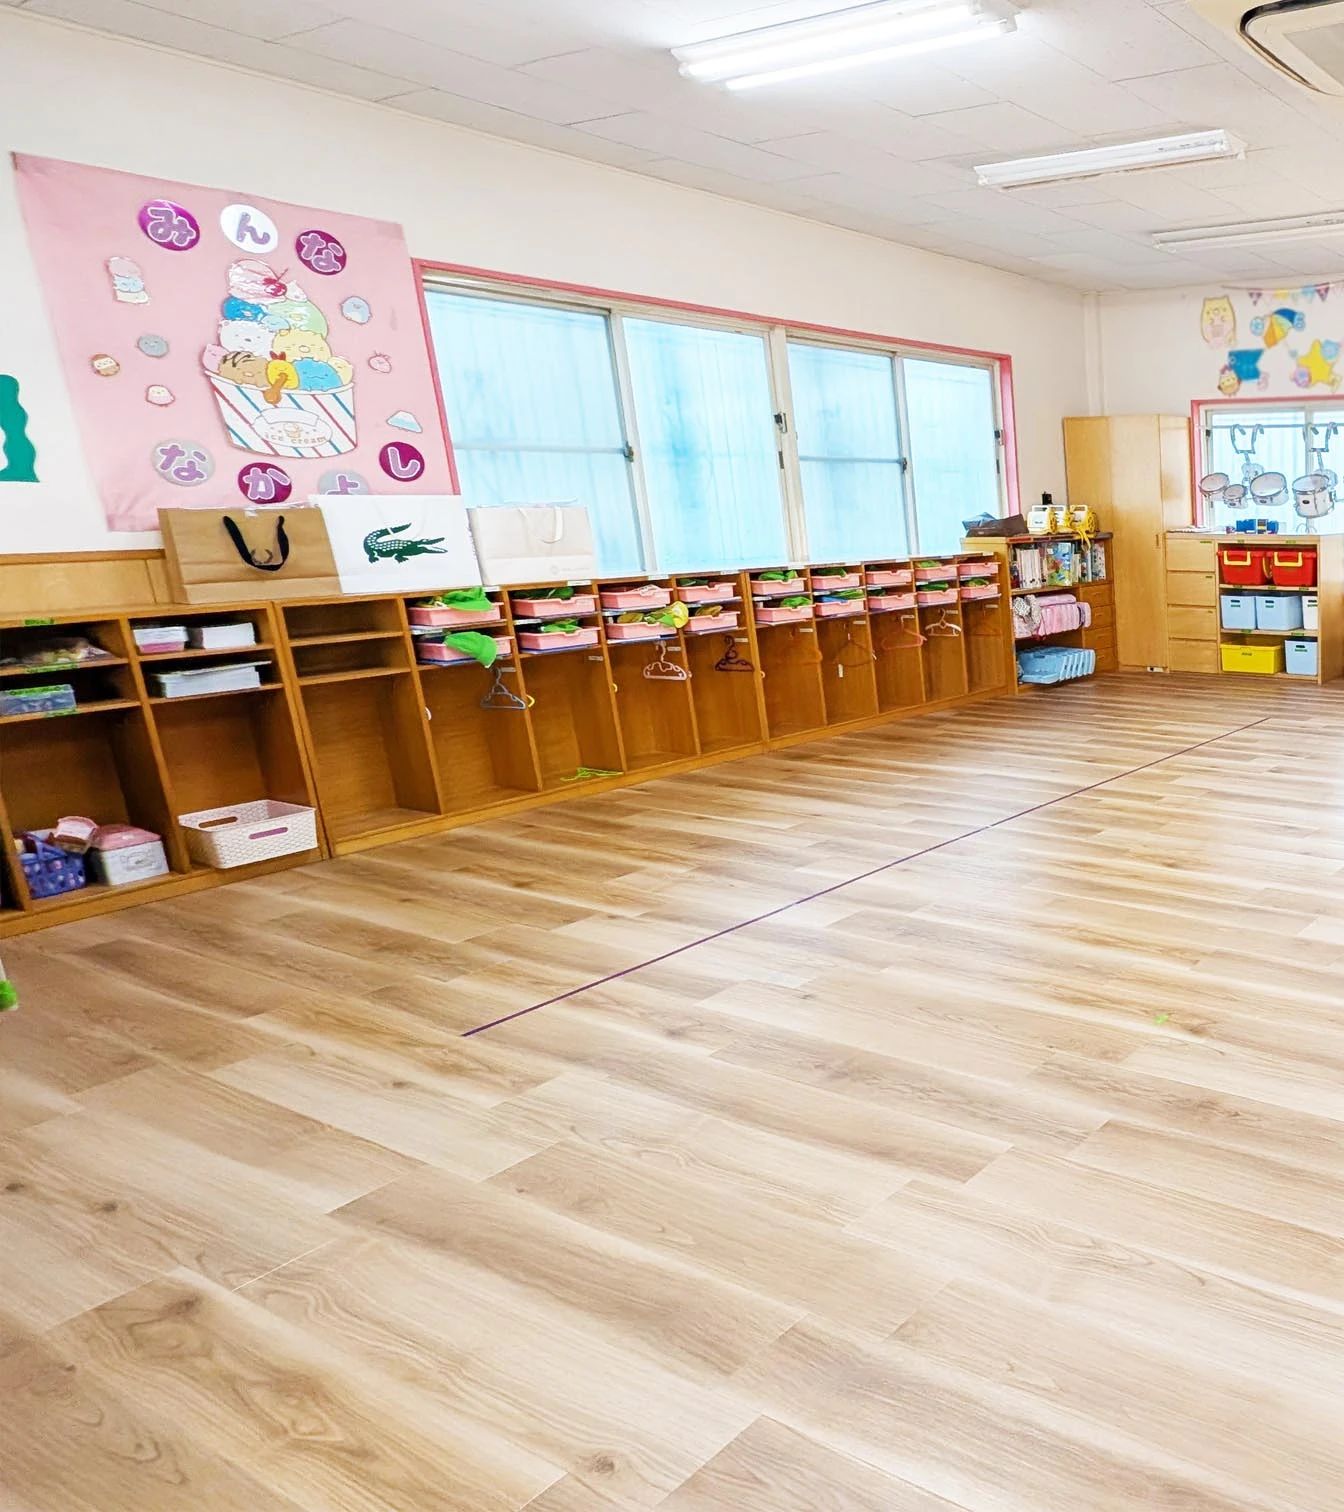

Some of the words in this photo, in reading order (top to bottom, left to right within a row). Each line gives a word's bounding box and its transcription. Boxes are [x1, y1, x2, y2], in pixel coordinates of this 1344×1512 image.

[147, 207, 344, 272] みんな
[291, 435, 326, 444] cream
